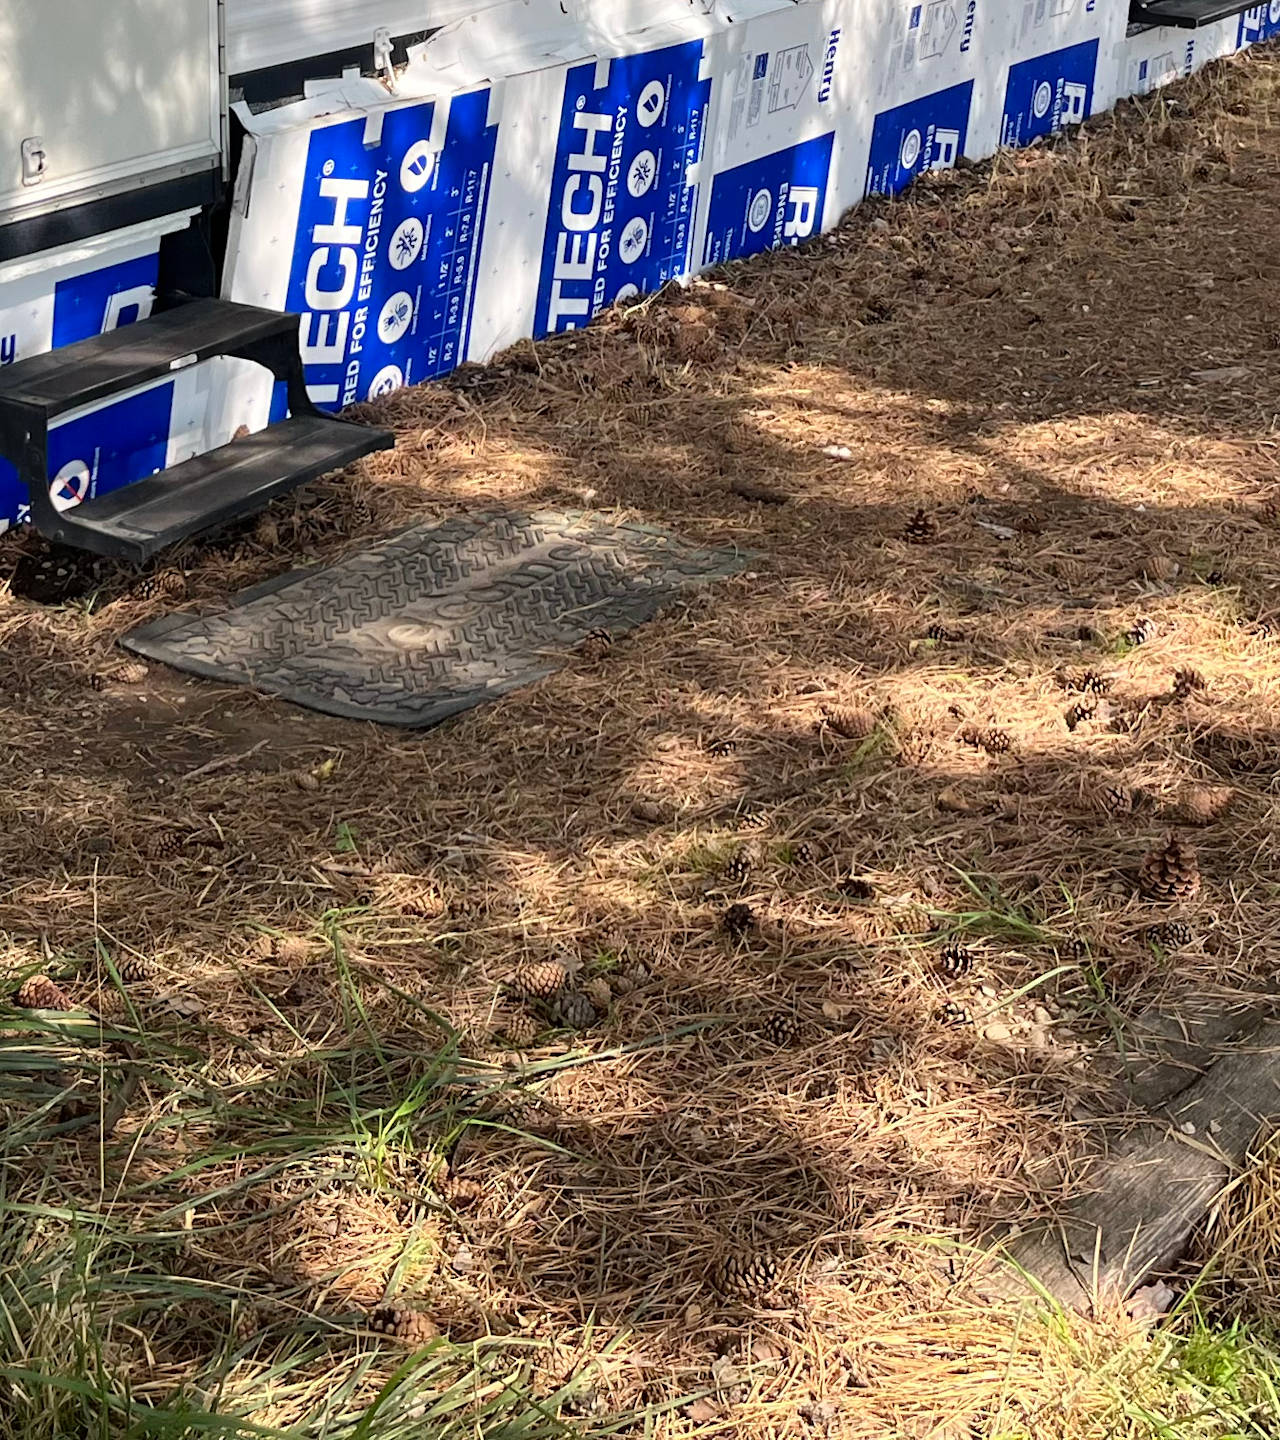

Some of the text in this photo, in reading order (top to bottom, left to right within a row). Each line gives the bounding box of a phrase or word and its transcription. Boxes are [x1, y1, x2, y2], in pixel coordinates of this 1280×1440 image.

[817, 28, 841, 103] Henry
[465, 169, 478, 204] R-11.7
[603, 105, 628, 224] EFFICIENCY
[357, 169, 389, 301] EFFICIENCY
[547, 111, 613, 332] TECH
[597, 229, 612, 272] FOR
[349, 305, 369, 354] FOR
[448, 295, 460, 325] R-3.9
[443, 341, 455, 361] R-2
